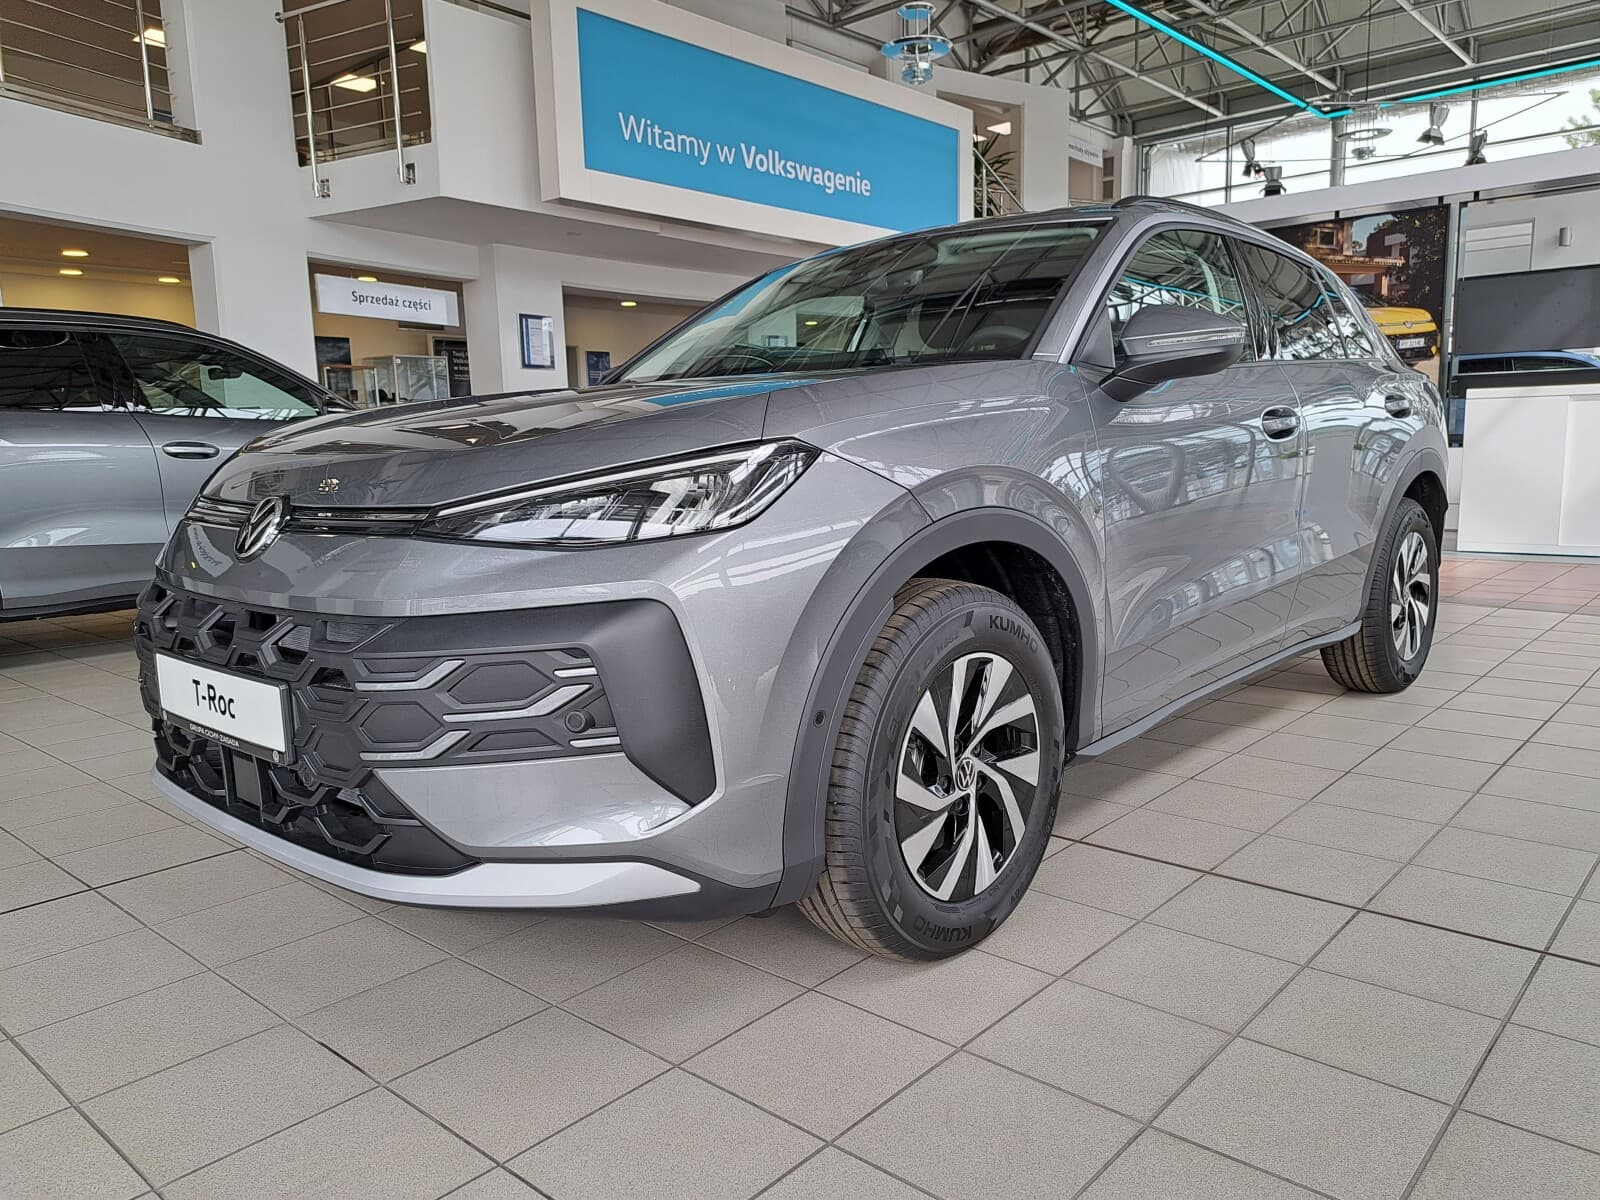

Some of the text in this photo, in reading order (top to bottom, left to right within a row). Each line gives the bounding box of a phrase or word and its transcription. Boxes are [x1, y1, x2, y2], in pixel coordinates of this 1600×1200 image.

[618, 111, 872, 197] Witamy w Volkswagenie
[351, 290, 432, 313] Sprzedaż części
[988, 614, 1039, 654] KUMHO
[192, 679, 236, 719] T-Roc
[912, 914, 972, 943] KUMHO
